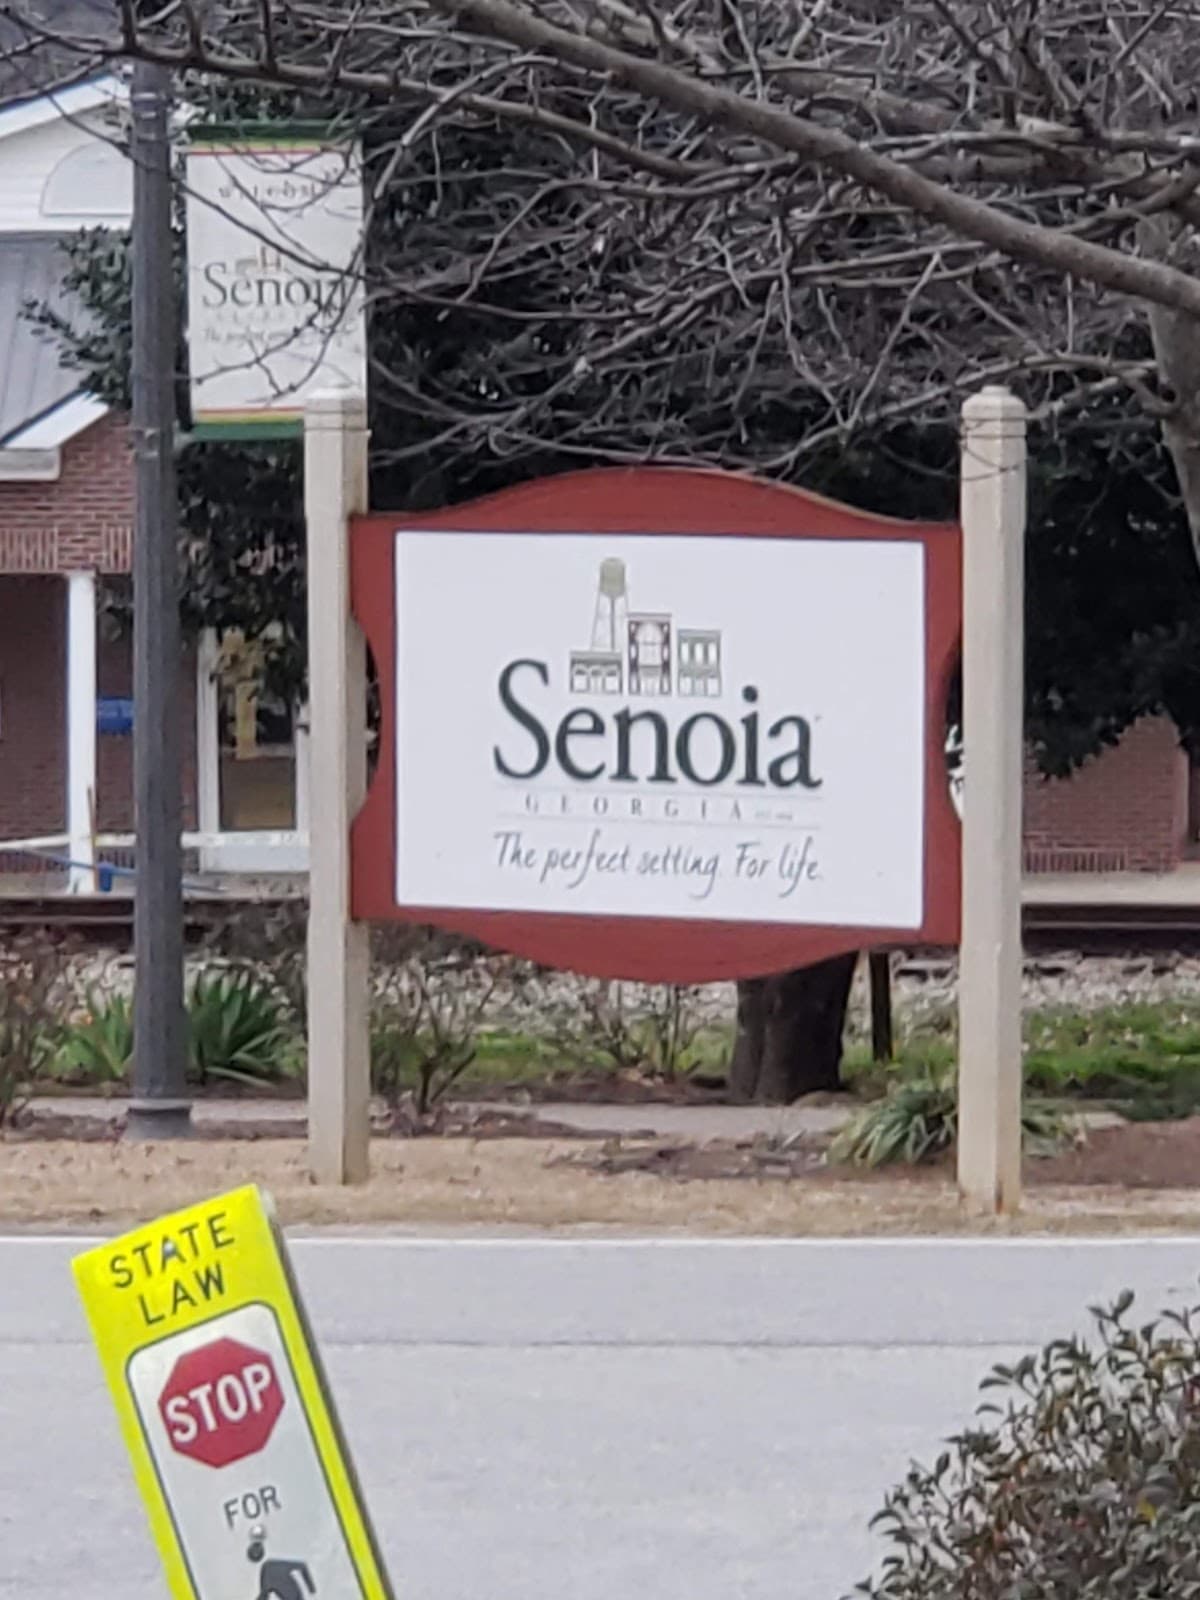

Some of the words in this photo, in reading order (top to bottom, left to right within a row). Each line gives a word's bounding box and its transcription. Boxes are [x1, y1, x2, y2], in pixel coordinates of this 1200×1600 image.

[493, 658, 823, 790] Senoia
[525, 794, 743, 820] GEORGIA
[493, 831, 536, 871] The
[539, 828, 630, 889] perfect
[735, 841, 771, 879] For
[109, 1211, 235, 1289] STATE
[137, 1263, 226, 1327] LAW
[164, 1361, 273, 1445] STOP
[222, 1484, 282, 1530] FOR
